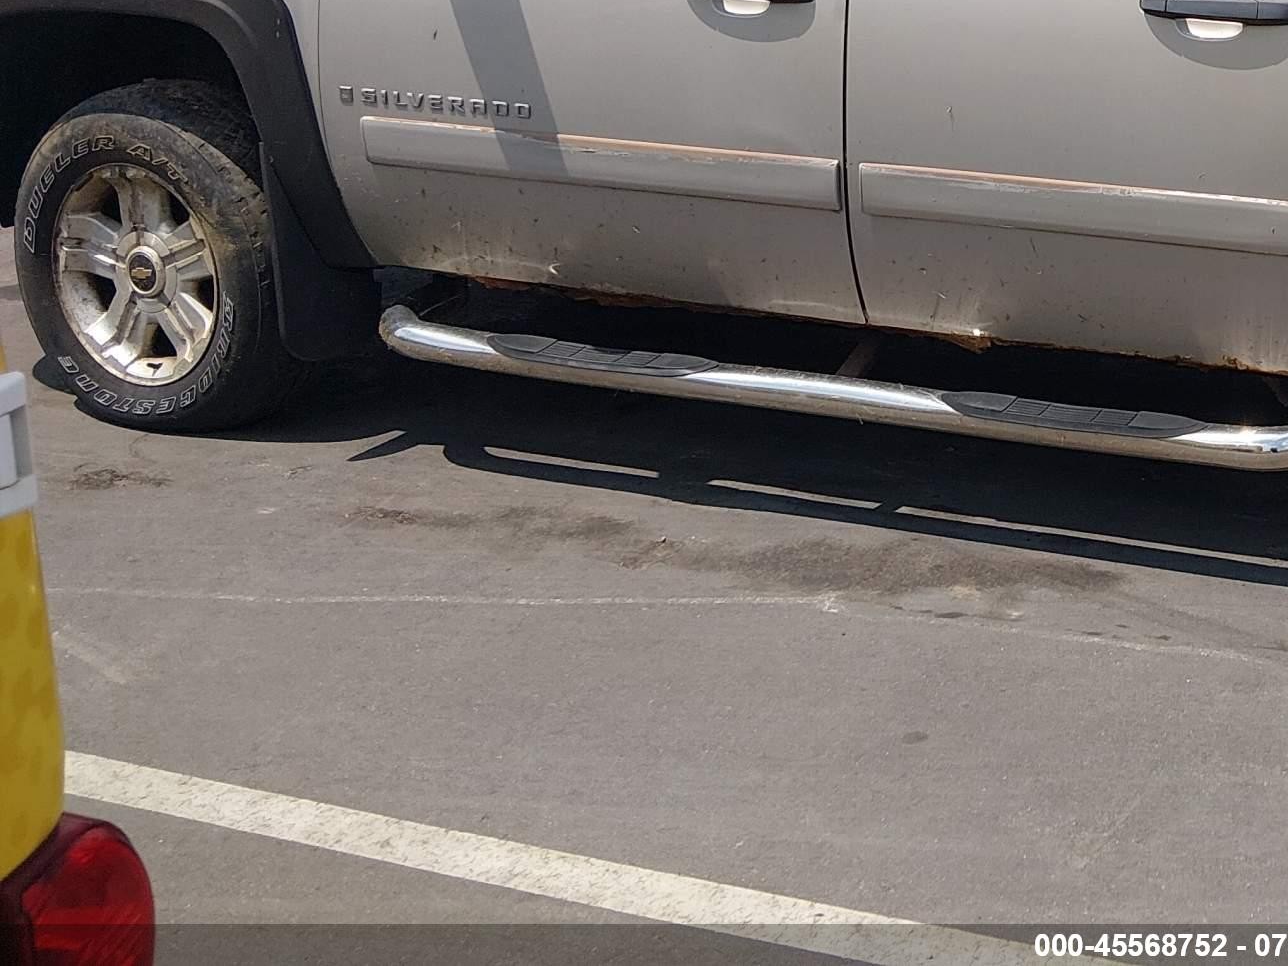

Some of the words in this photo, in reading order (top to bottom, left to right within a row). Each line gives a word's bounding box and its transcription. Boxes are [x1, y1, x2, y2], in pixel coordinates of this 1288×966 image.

[361, 87, 532, 119] SILVERADO
[23, 135, 115, 253] DUELER
[58, 290, 235, 415] BRIDGESTONE
